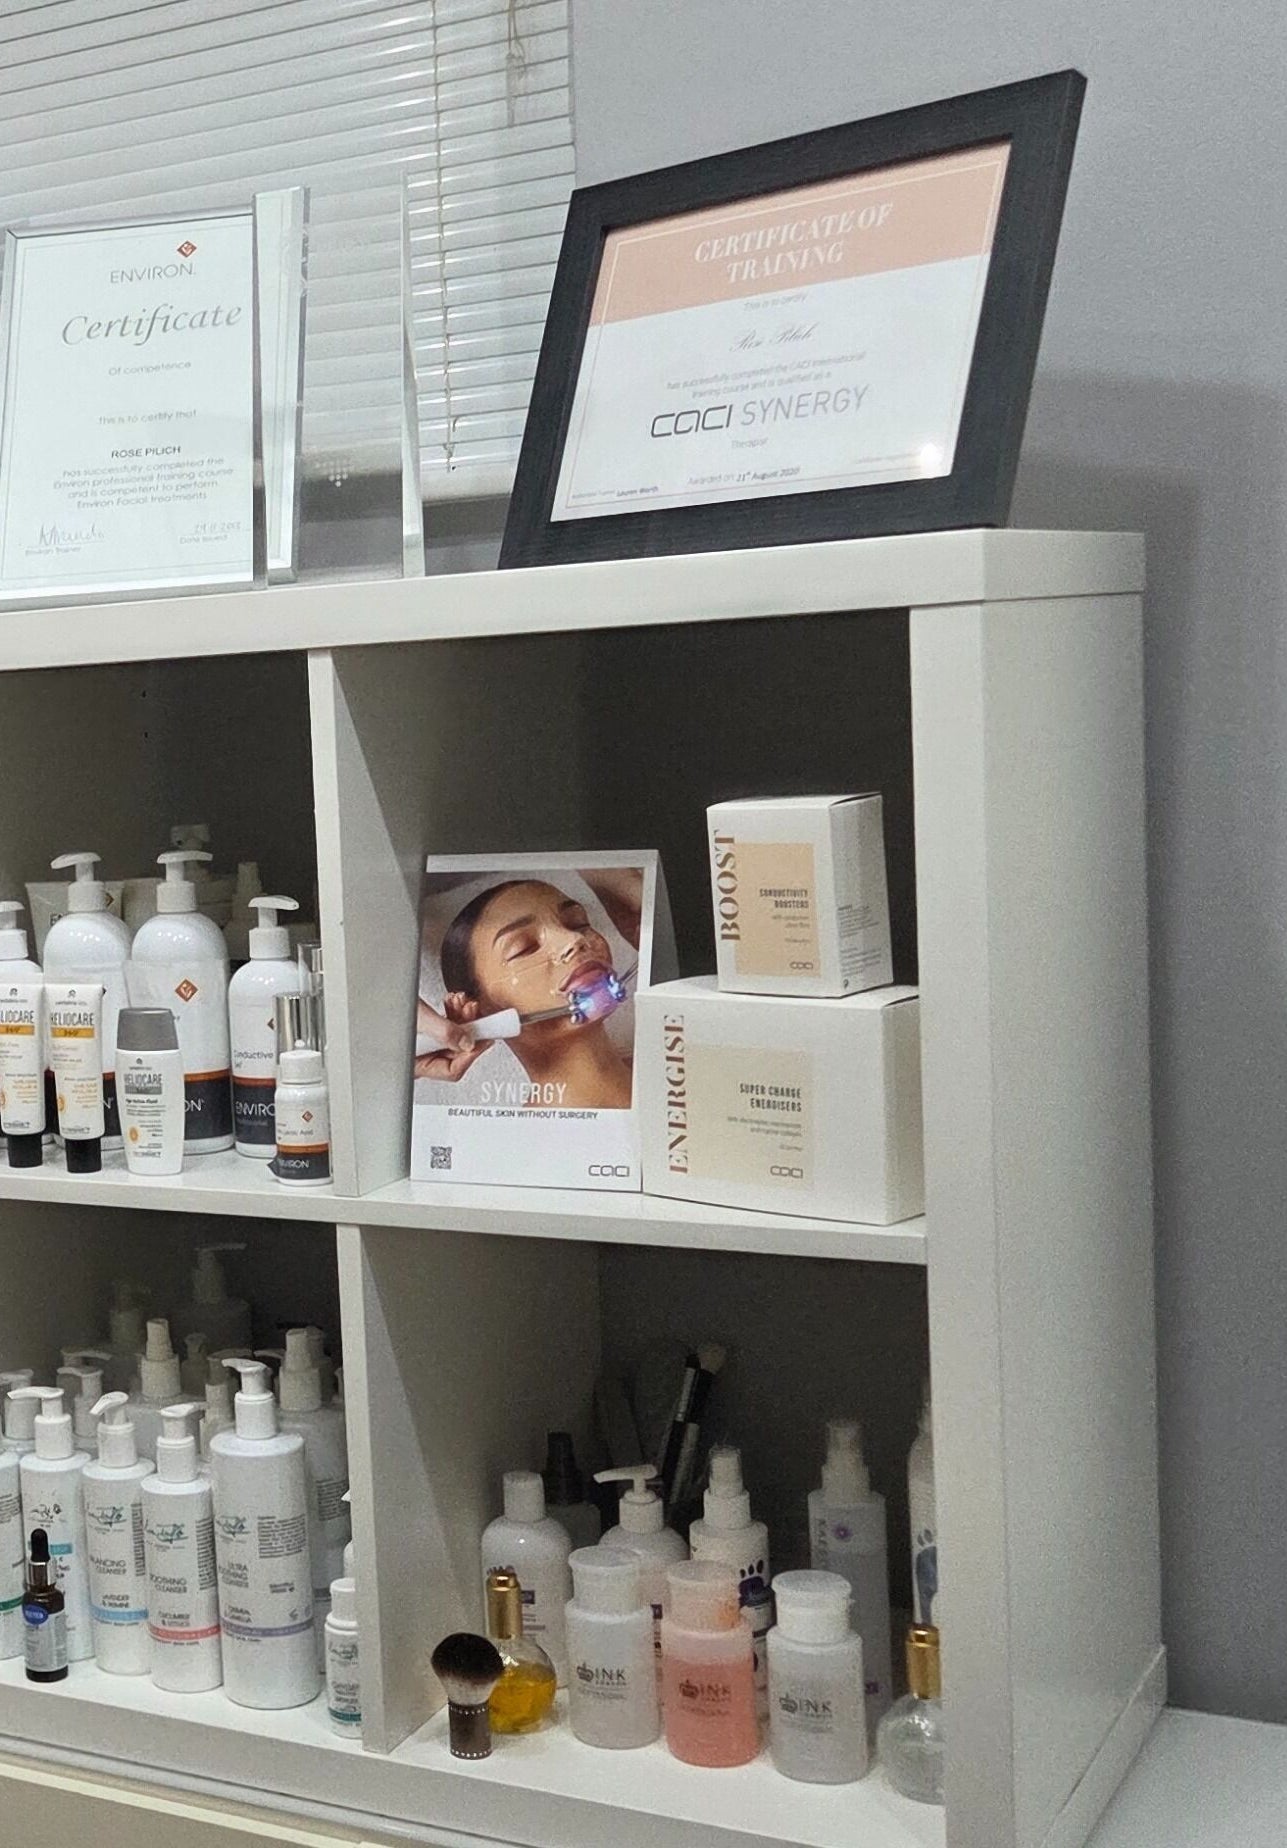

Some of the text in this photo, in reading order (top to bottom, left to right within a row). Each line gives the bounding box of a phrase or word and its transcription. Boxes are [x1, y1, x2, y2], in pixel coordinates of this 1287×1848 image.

[695, 202, 894, 263] CERTIFICATE OF
[727, 241, 844, 284] TRAINING
[109, 262, 196, 285] ENVIRON
[61, 303, 242, 347] Certificate
[124, 360, 191, 376] competence
[740, 385, 869, 426] SYNERGY
[111, 446, 181, 459] ROSE PILICH
[84, 466, 143, 477] successfully
[146, 459, 205, 472] completed
[92, 474, 154, 487] professional
[157, 470, 195, 483] training
[199, 468, 234, 478] course
[100, 486, 159, 498] competent
[176, 480, 218, 491] perform
[713, 829, 742, 941] BOOST
[481, 1081, 568, 1105] SYNERGY
[663, 1014, 689, 1174] ENERGISE
[739, 1083, 802, 1099] SUPER CHARGE
[448, 1108, 599, 1120] BEAUTIFUL SKIN WITHOUT SURGERY
[750, 1098, 802, 1112] ENERGISERS
[595, 1668, 626, 1681] INK
[700, 1684, 731, 1698] INK
[799, 1701, 832, 1713] INK
